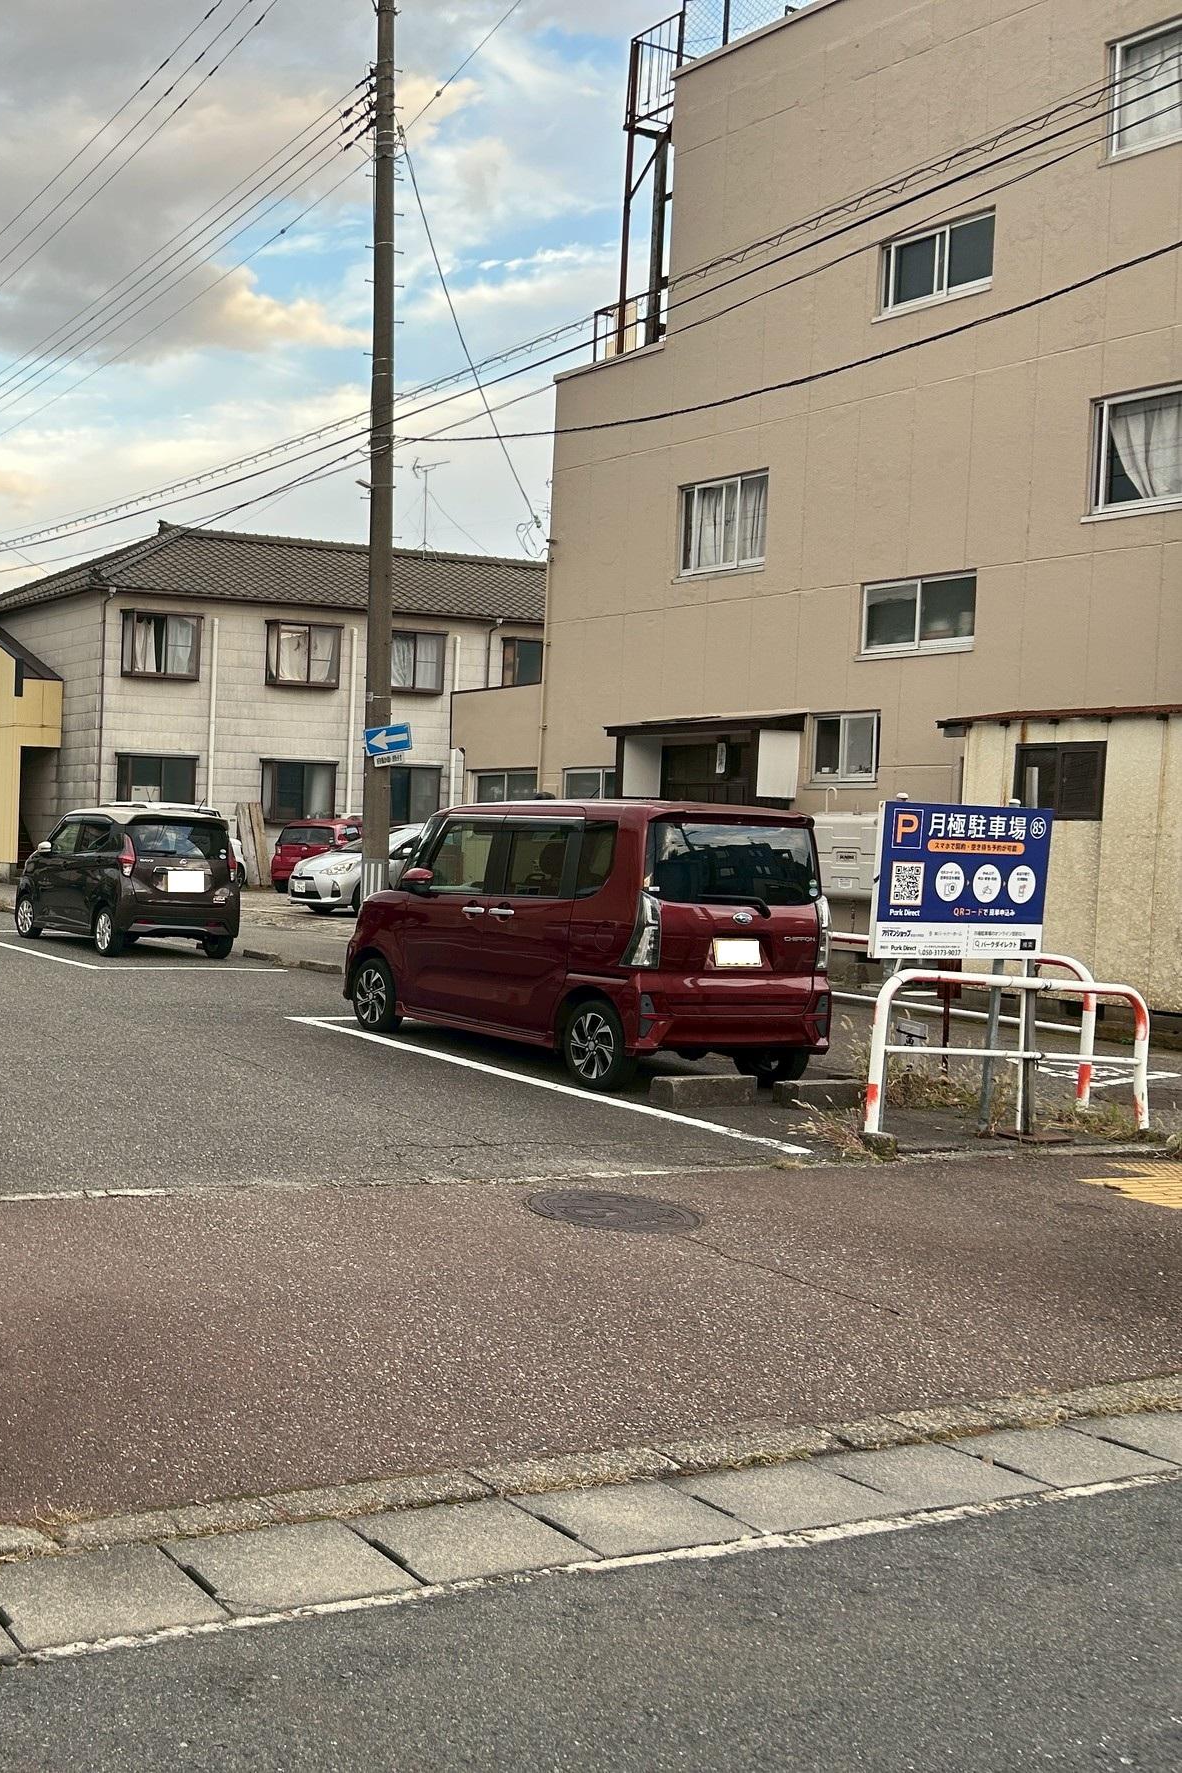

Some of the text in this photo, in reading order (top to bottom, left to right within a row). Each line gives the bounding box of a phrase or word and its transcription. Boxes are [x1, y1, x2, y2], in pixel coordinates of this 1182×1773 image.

[897, 813, 919, 843] P
[928, 812, 1026, 841] 月極駐車場
[889, 908, 921, 917] Park Direct
